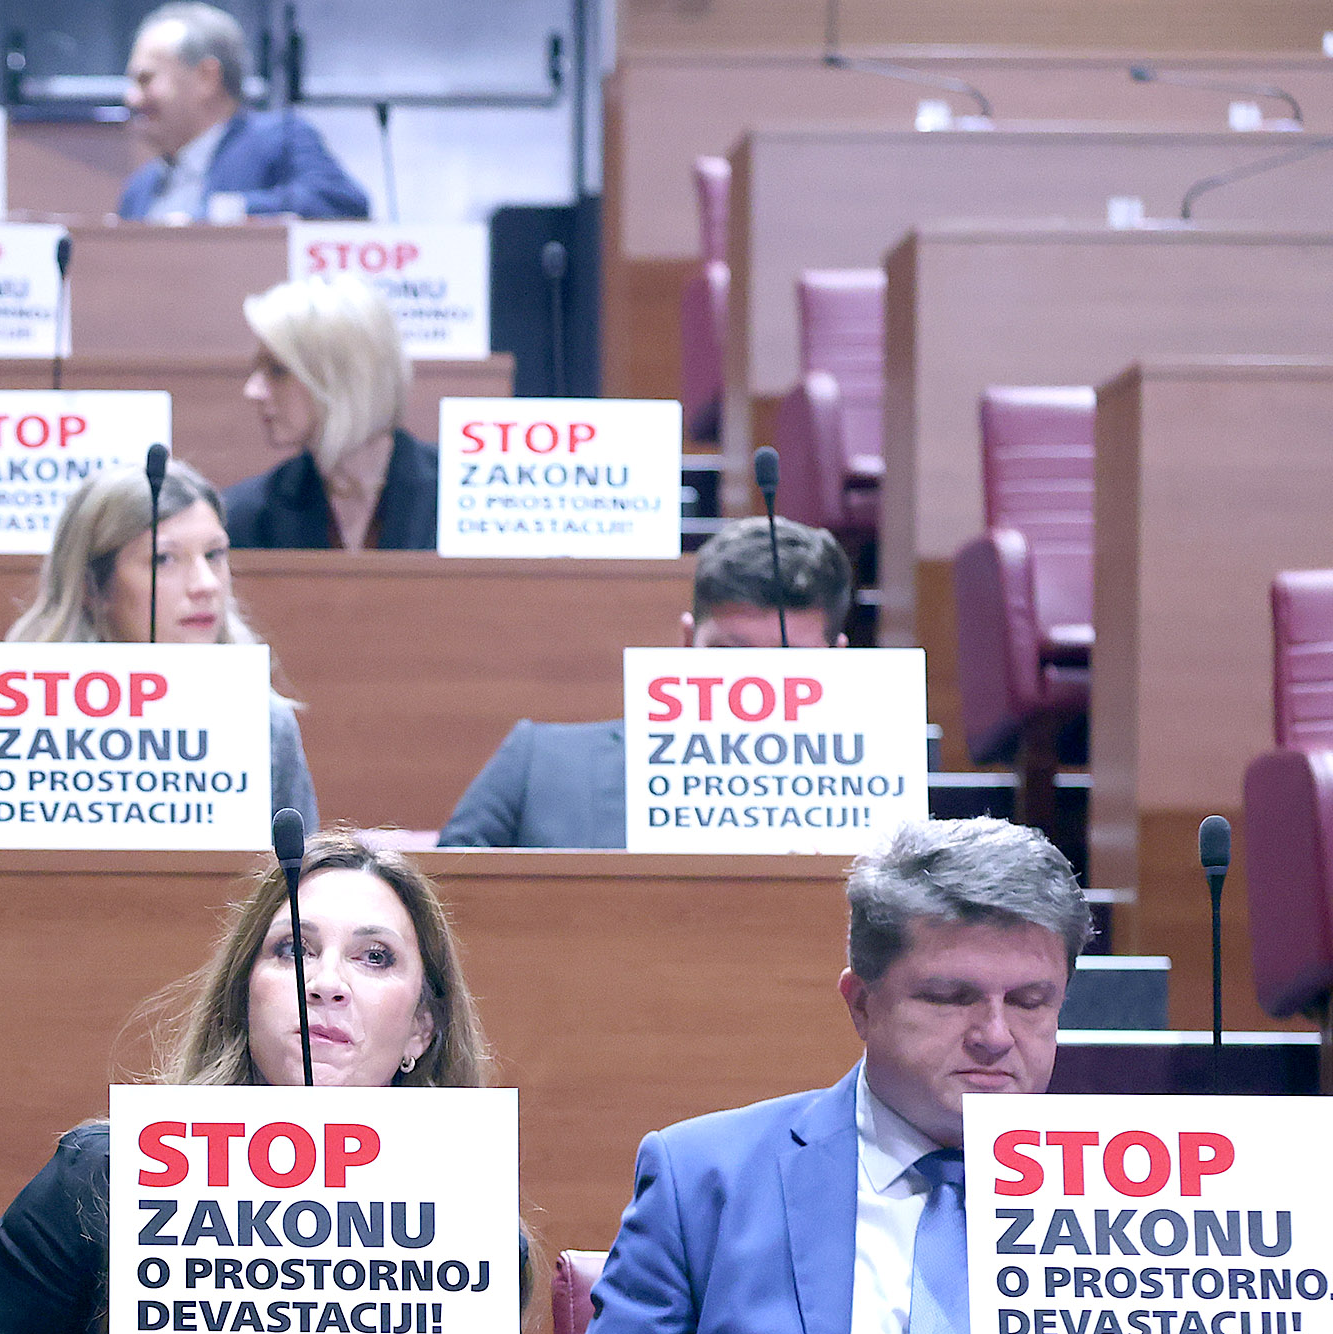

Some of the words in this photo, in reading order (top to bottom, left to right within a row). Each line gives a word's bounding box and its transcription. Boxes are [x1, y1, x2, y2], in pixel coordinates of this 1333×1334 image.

[305, 242, 419, 273] STOP
[460, 421, 596, 455] STOP
[459, 463, 629, 488] ZAKONU
[647, 676, 823, 723] STOP
[648, 733, 864, 766] ZAKONU
[28, 770, 248, 793] PROSTORNOJ
[647, 775, 670, 797] O
[683, 775, 904, 798] PROSTORNOJ
[648, 806, 871, 829] DEVASTACIJI!
[138, 1121, 380, 1188] STOP
[994, 1130, 1235, 1197] STOP
[138, 1200, 435, 1248] ZAKONU
[996, 1209, 1292, 1257] ZAKONU
[137, 1257, 170, 1288] O
[186, 1258, 489, 1292] PROSTORNOJ
[997, 1266, 1029, 1297] O
[1045, 1267, 1333, 1300] PROSTORNO
[138, 1301, 442, 1334] DEVASTACIJI!
